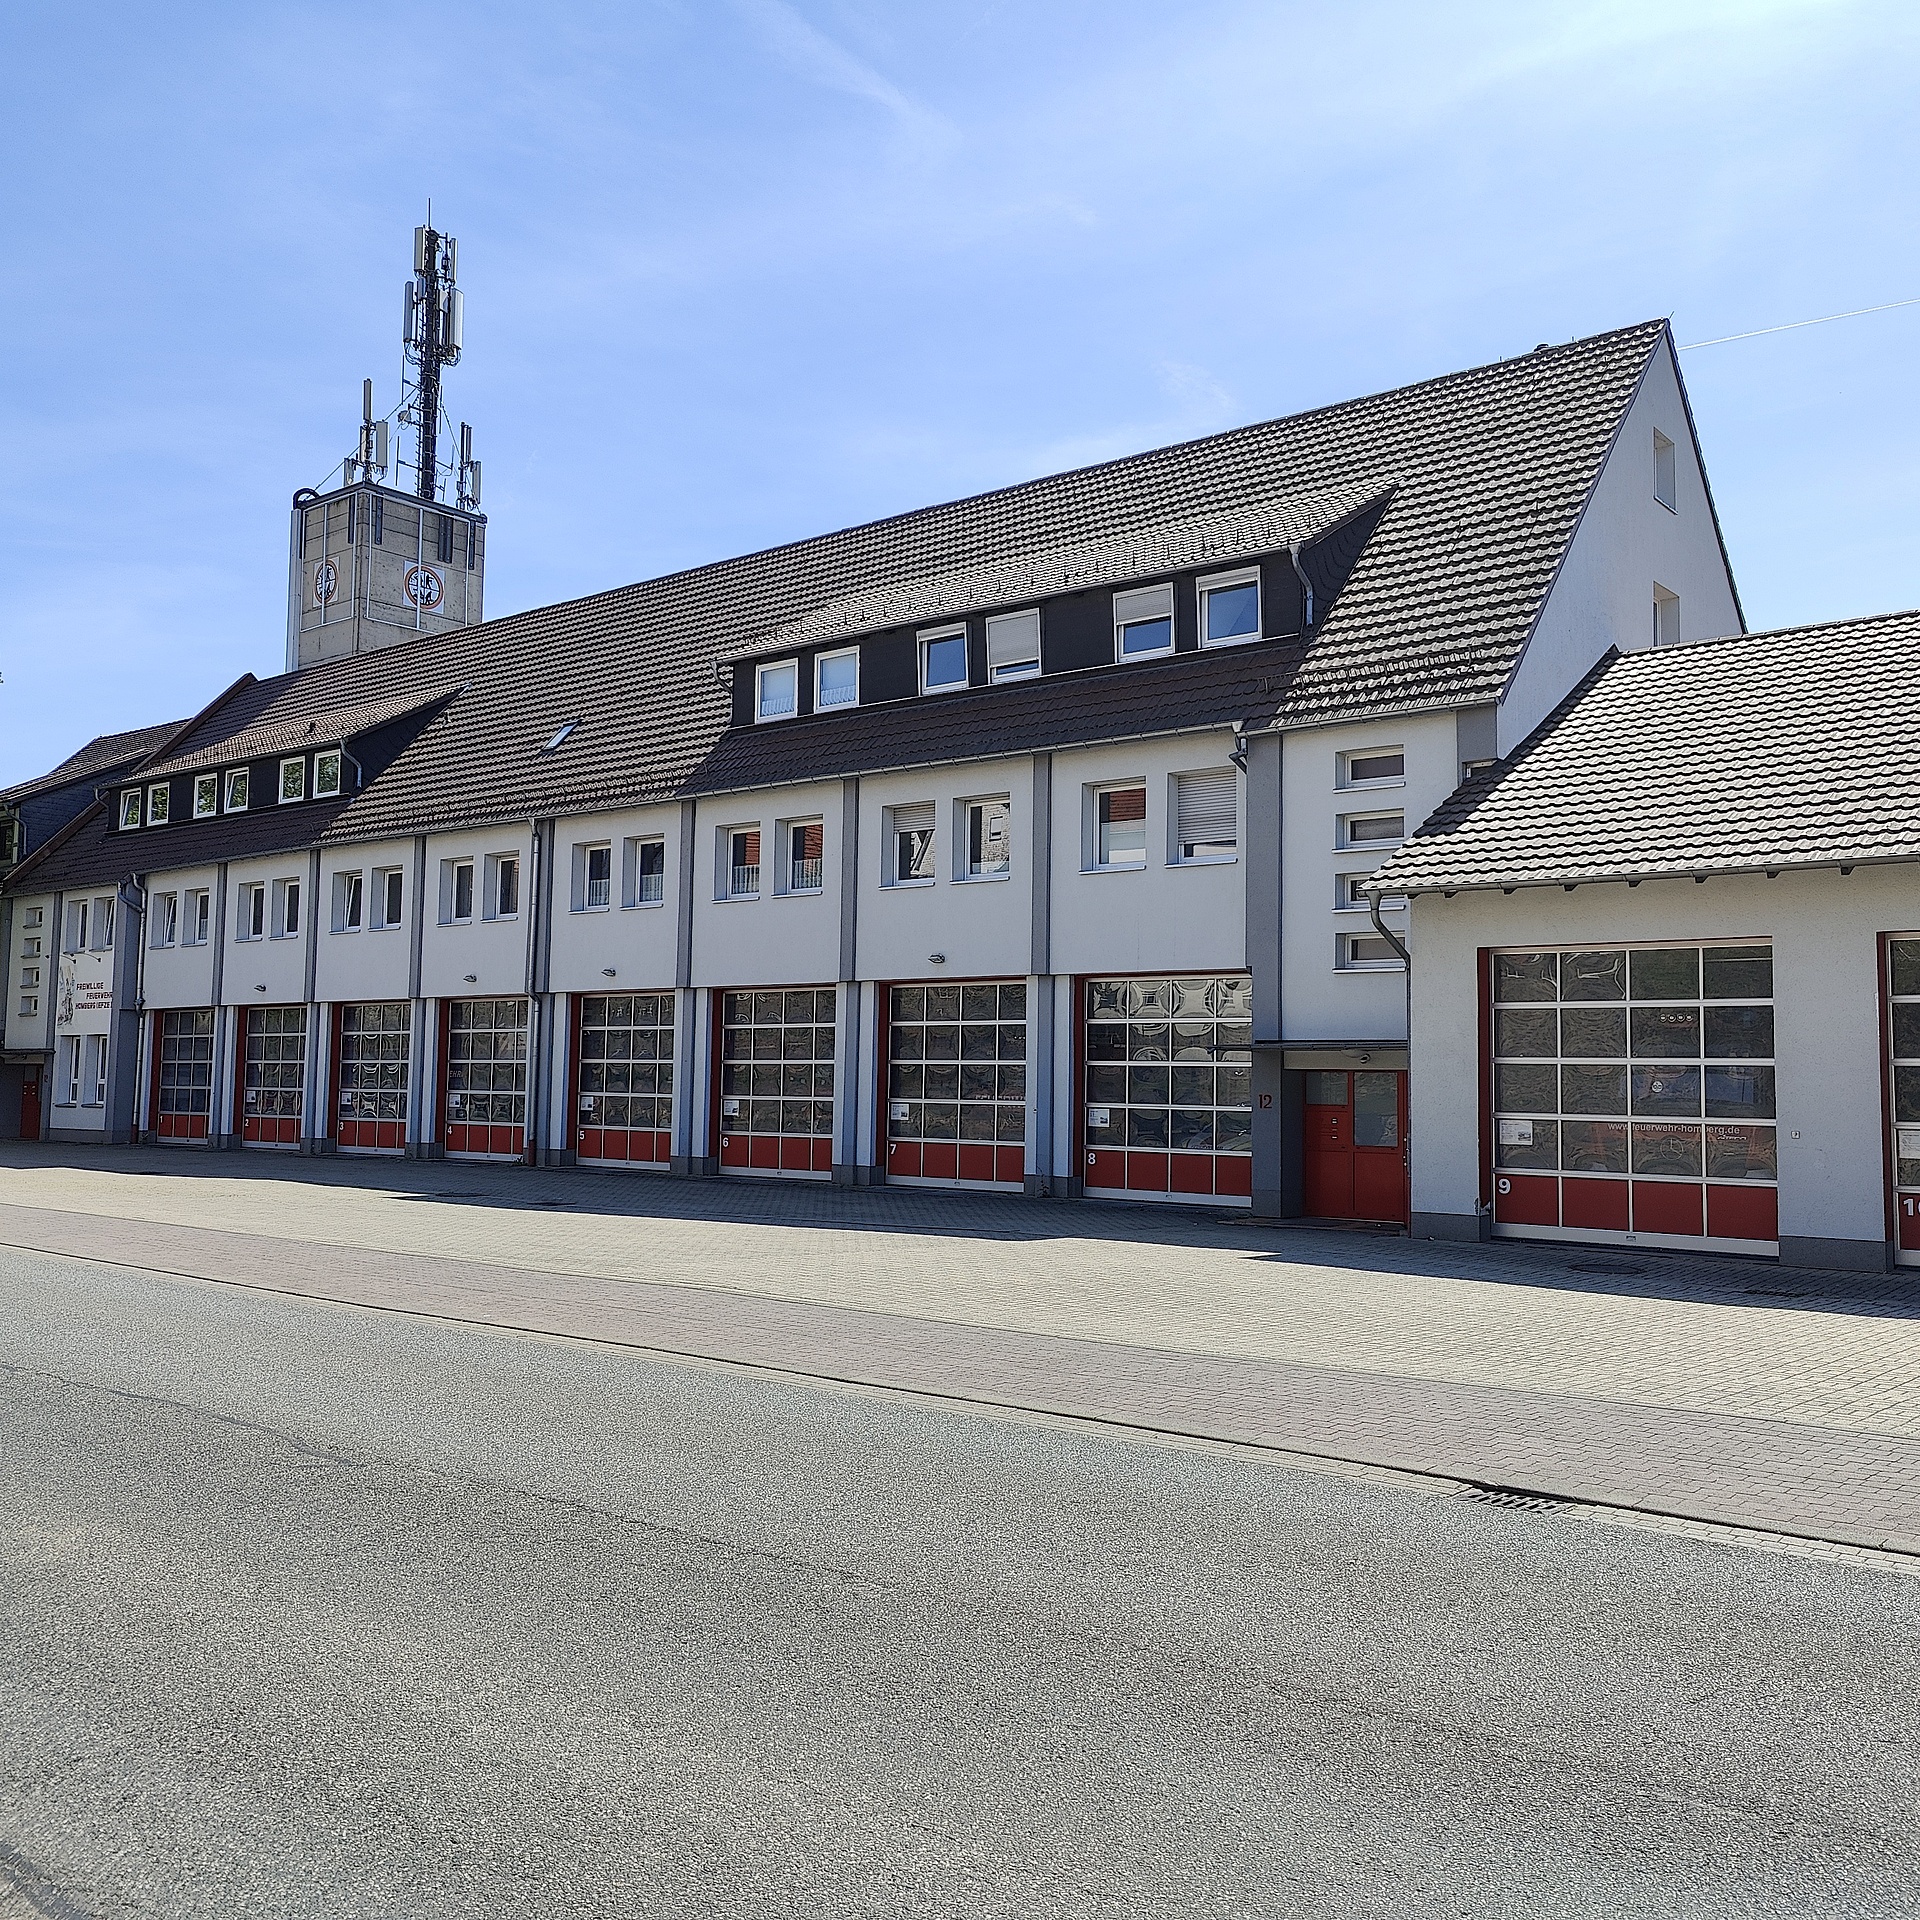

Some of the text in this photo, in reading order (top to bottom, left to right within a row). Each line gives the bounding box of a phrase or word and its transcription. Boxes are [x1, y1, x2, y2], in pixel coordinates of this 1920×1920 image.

[1259, 1094, 1272, 1108] 12
[245, 1118, 249, 1127] 2
[340, 1122, 344, 1130] 3
[447, 1126, 452, 1134] 4
[580, 1130, 585, 1140] 5
[723, 1137, 729, 1147] 6
[890, 1144, 897, 1154] 7
[1088, 1152, 1096, 1164] 8
[1498, 1178, 1511, 1194] 9
[1903, 1198, 1920, 1216] 1
